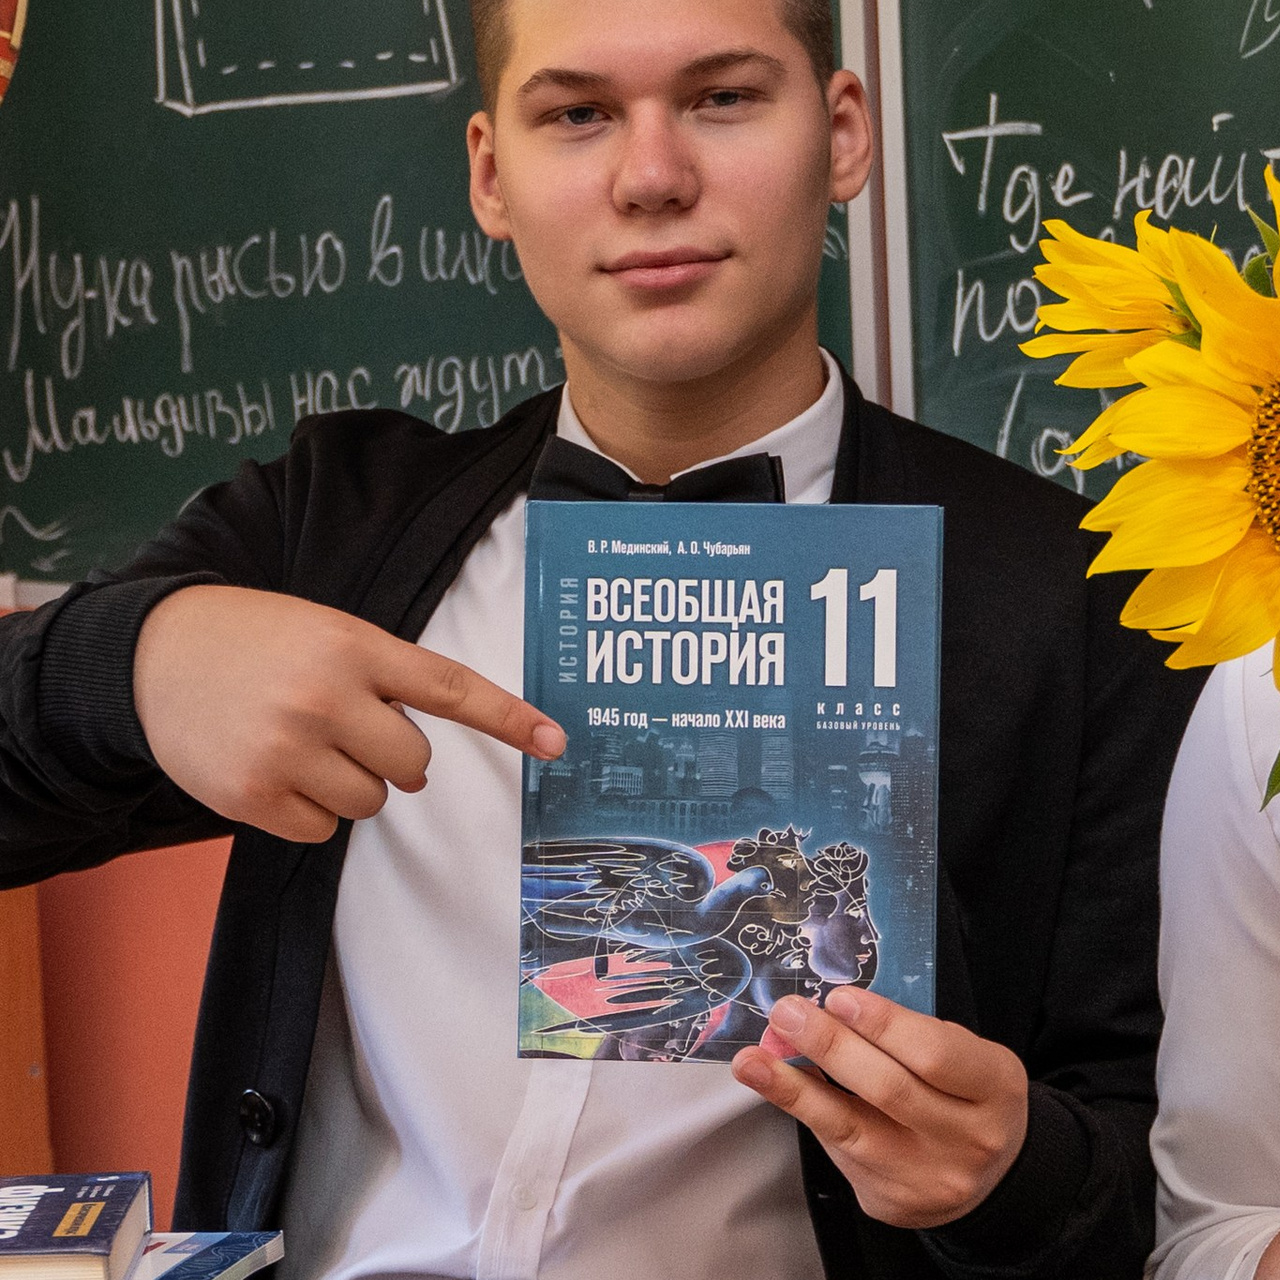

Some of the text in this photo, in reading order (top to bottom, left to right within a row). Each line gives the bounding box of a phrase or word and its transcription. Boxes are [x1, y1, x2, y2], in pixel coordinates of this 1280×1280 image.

[170, 227, 348, 374] рысью
[367, 194, 404, 288] в
[587, 540, 751, 557] В. Р. Мединский, А. О. Чубарьян
[558, 577, 580, 684] ИСТОРИЯ
[586, 577, 786, 631] ВСЕОБЩАЯ
[810, 568, 899, 688] 11
[586, 628, 786, 686] ИСТОРИЯ
[587, 707, 621, 727] 1945
[623, 711, 649, 729] год
[671, 712, 721, 729] начало
[724, 709, 750, 729] XXI
[752, 713, 787, 729] века
[816, 720, 901, 731] БАЗОВЫЙ УРОВЕНЬ
